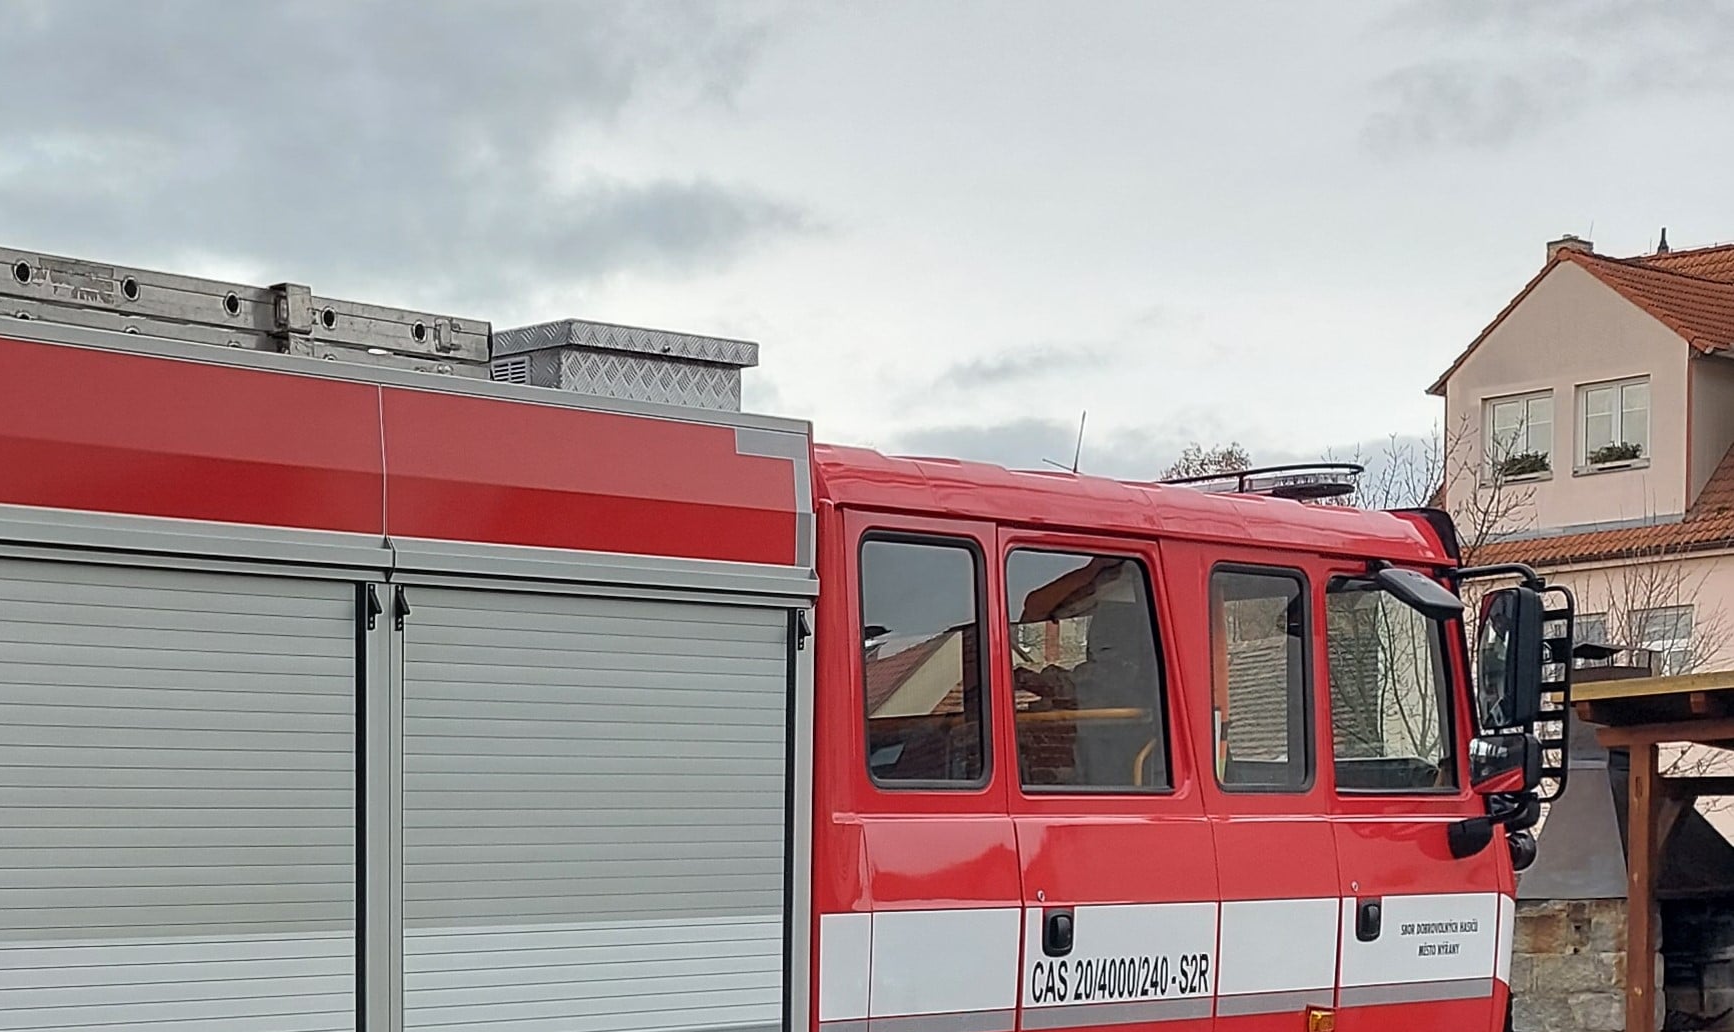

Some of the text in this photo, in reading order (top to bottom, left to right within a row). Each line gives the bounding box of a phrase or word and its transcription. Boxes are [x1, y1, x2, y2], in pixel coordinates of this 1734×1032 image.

[1400, 918, 1478, 936] SBOR DOBROVOLNÝCH HASIČŮ
[1418, 942, 1437, 956] MĚSTO
[1032, 959, 1069, 1003] CAS
